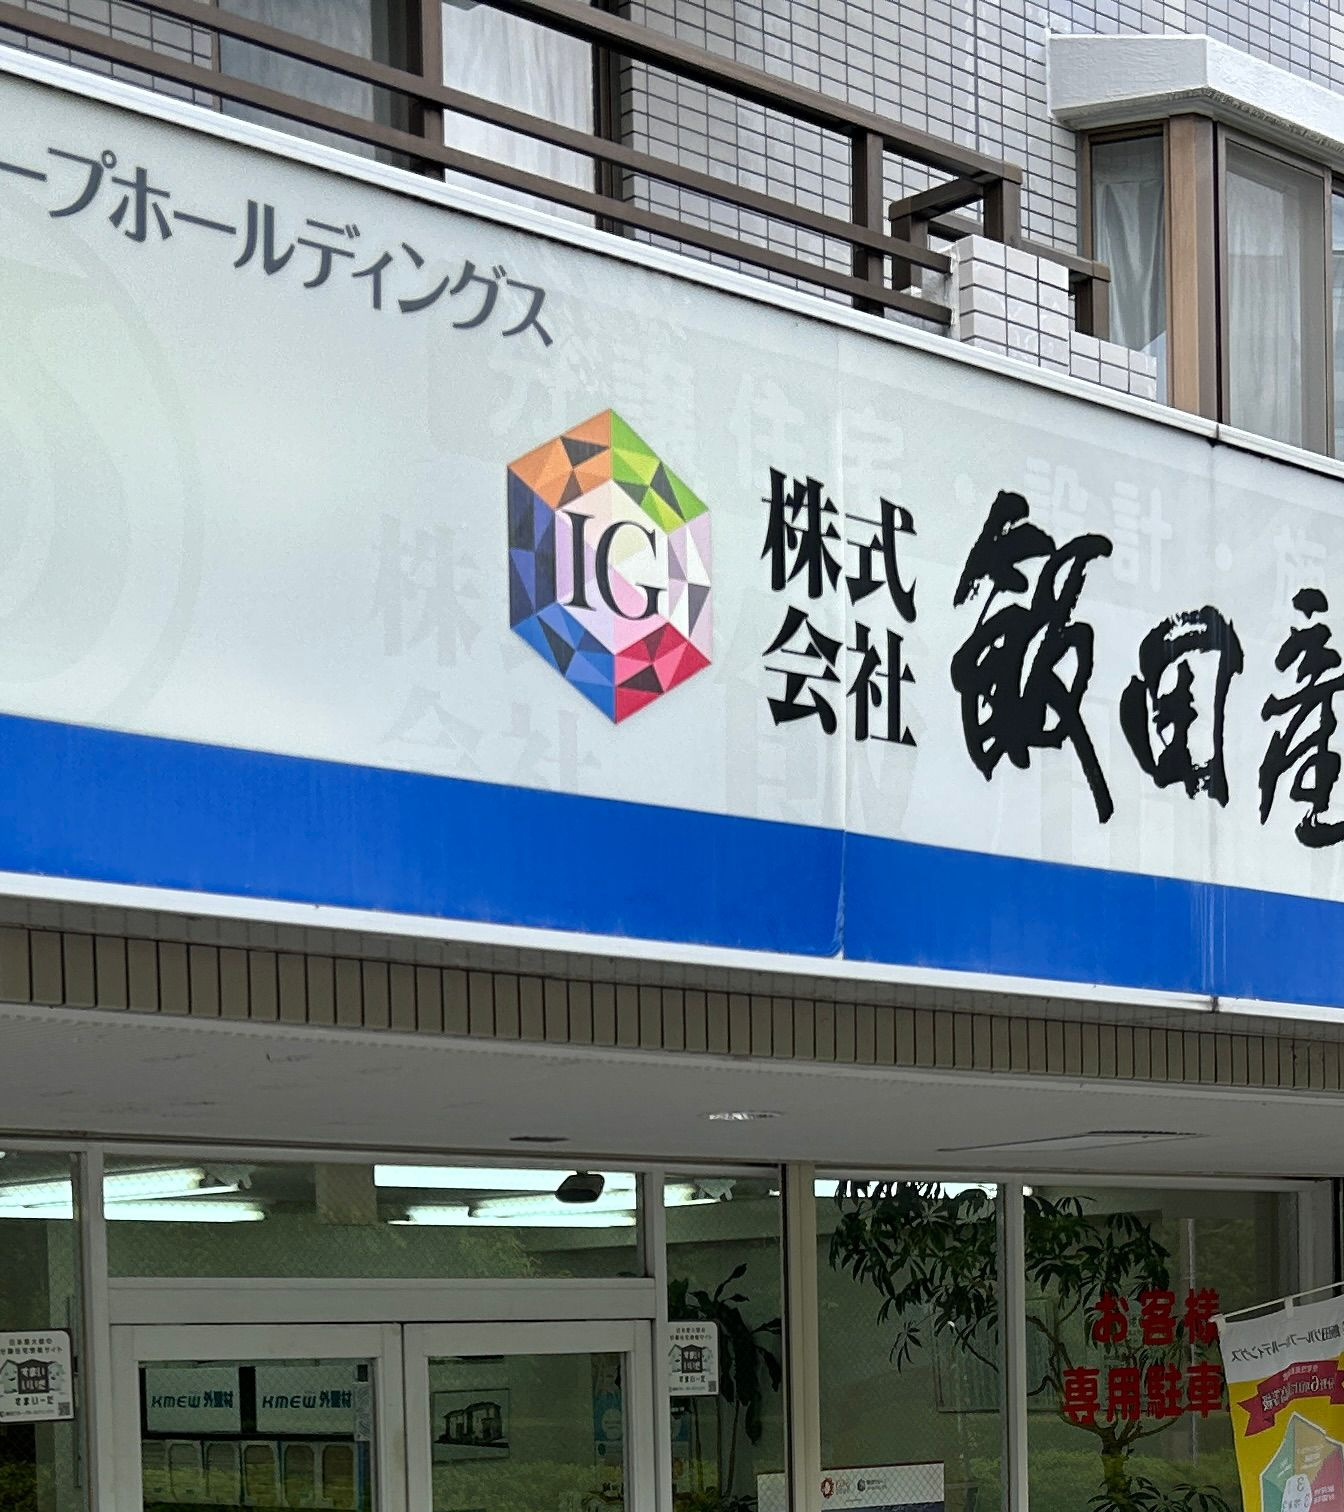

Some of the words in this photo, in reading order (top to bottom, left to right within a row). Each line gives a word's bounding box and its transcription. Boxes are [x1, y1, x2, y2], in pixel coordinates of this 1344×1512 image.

[557, 510, 668, 624] IG
[759, 466, 917, 623] 株式
[761, 607, 918, 748] 会社
[1092, 1287, 1220, 1345] お客様
[1062, 1361, 1223, 1425] 専用駐車
